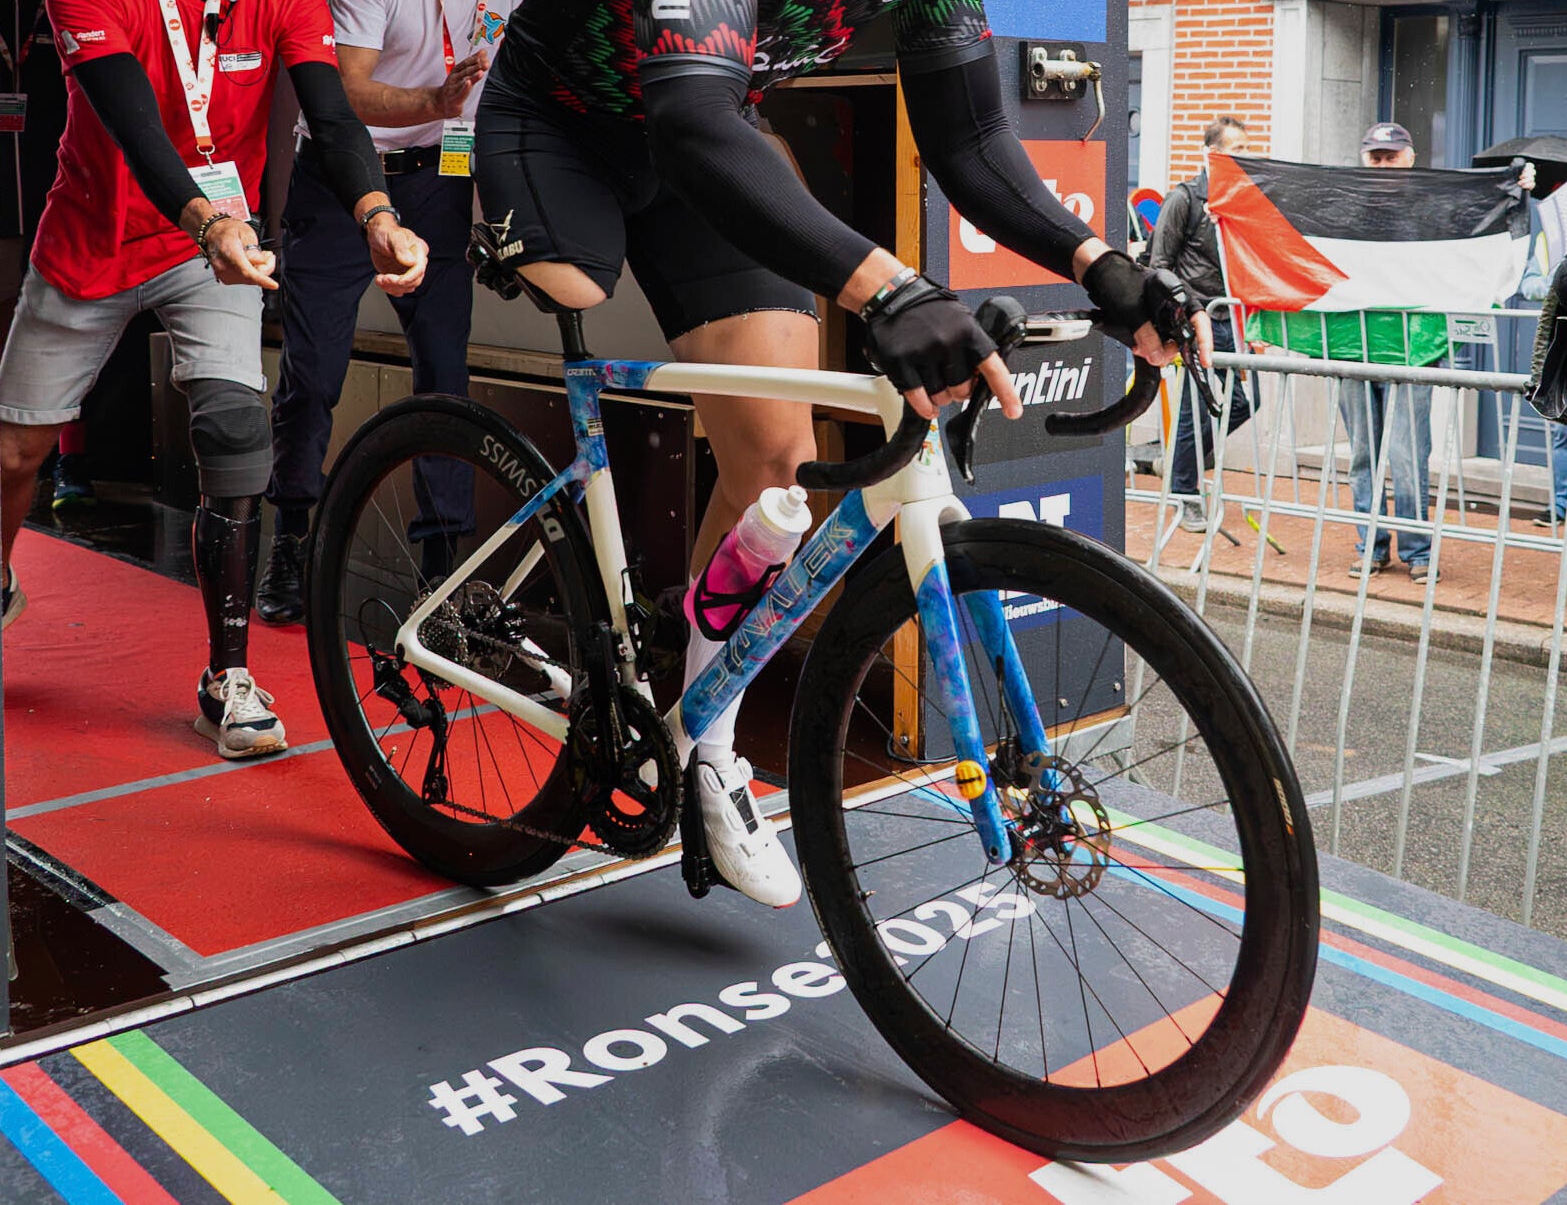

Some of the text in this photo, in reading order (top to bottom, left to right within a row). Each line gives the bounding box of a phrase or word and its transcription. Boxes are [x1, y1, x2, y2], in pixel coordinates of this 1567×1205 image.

[497, 239, 524, 261] LABU
[961, 357, 1093, 413] ntini
[480, 435, 538, 497] SWISS
